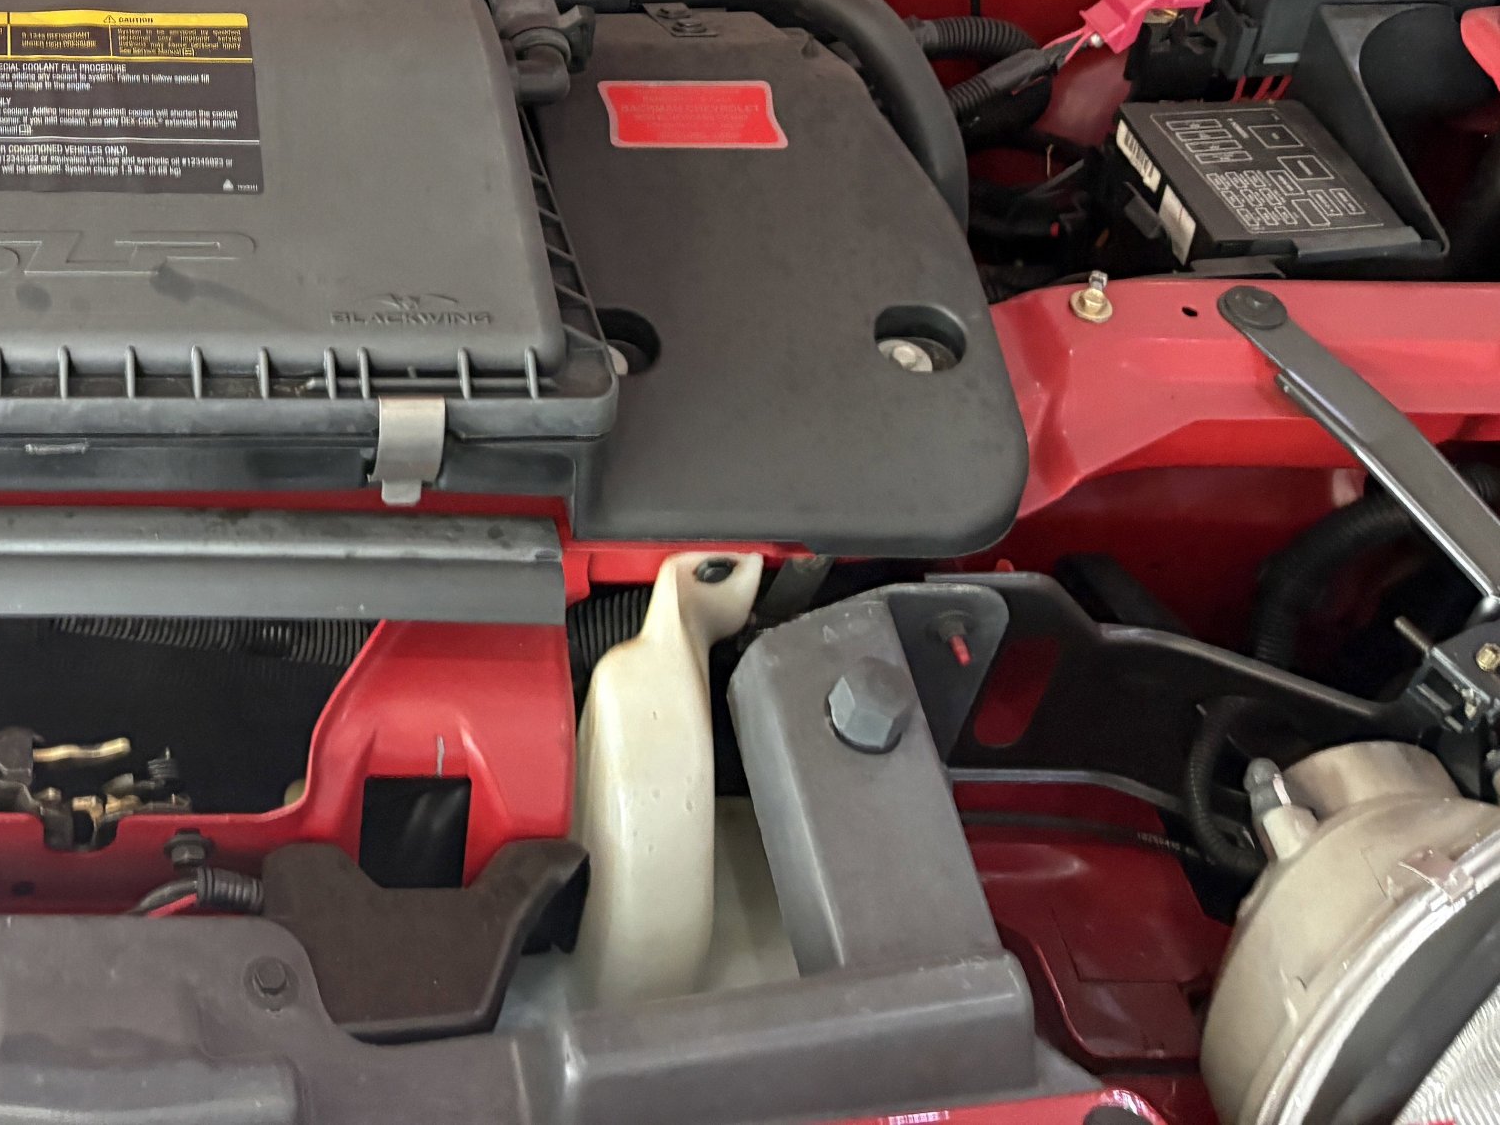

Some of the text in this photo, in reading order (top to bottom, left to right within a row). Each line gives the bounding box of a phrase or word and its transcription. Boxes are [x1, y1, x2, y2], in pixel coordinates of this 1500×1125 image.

[22, 63, 58, 71] COOLANT
[61, 63, 78, 72] FILL
[79, 64, 126, 72] PROCEDURE
[8, 145, 62, 155] CONDITIONED)
[64, 146, 102, 155] VEHICLES
[104, 146, 128, 156] ONLY)
[331, 311, 493, 325] BLACKWING
